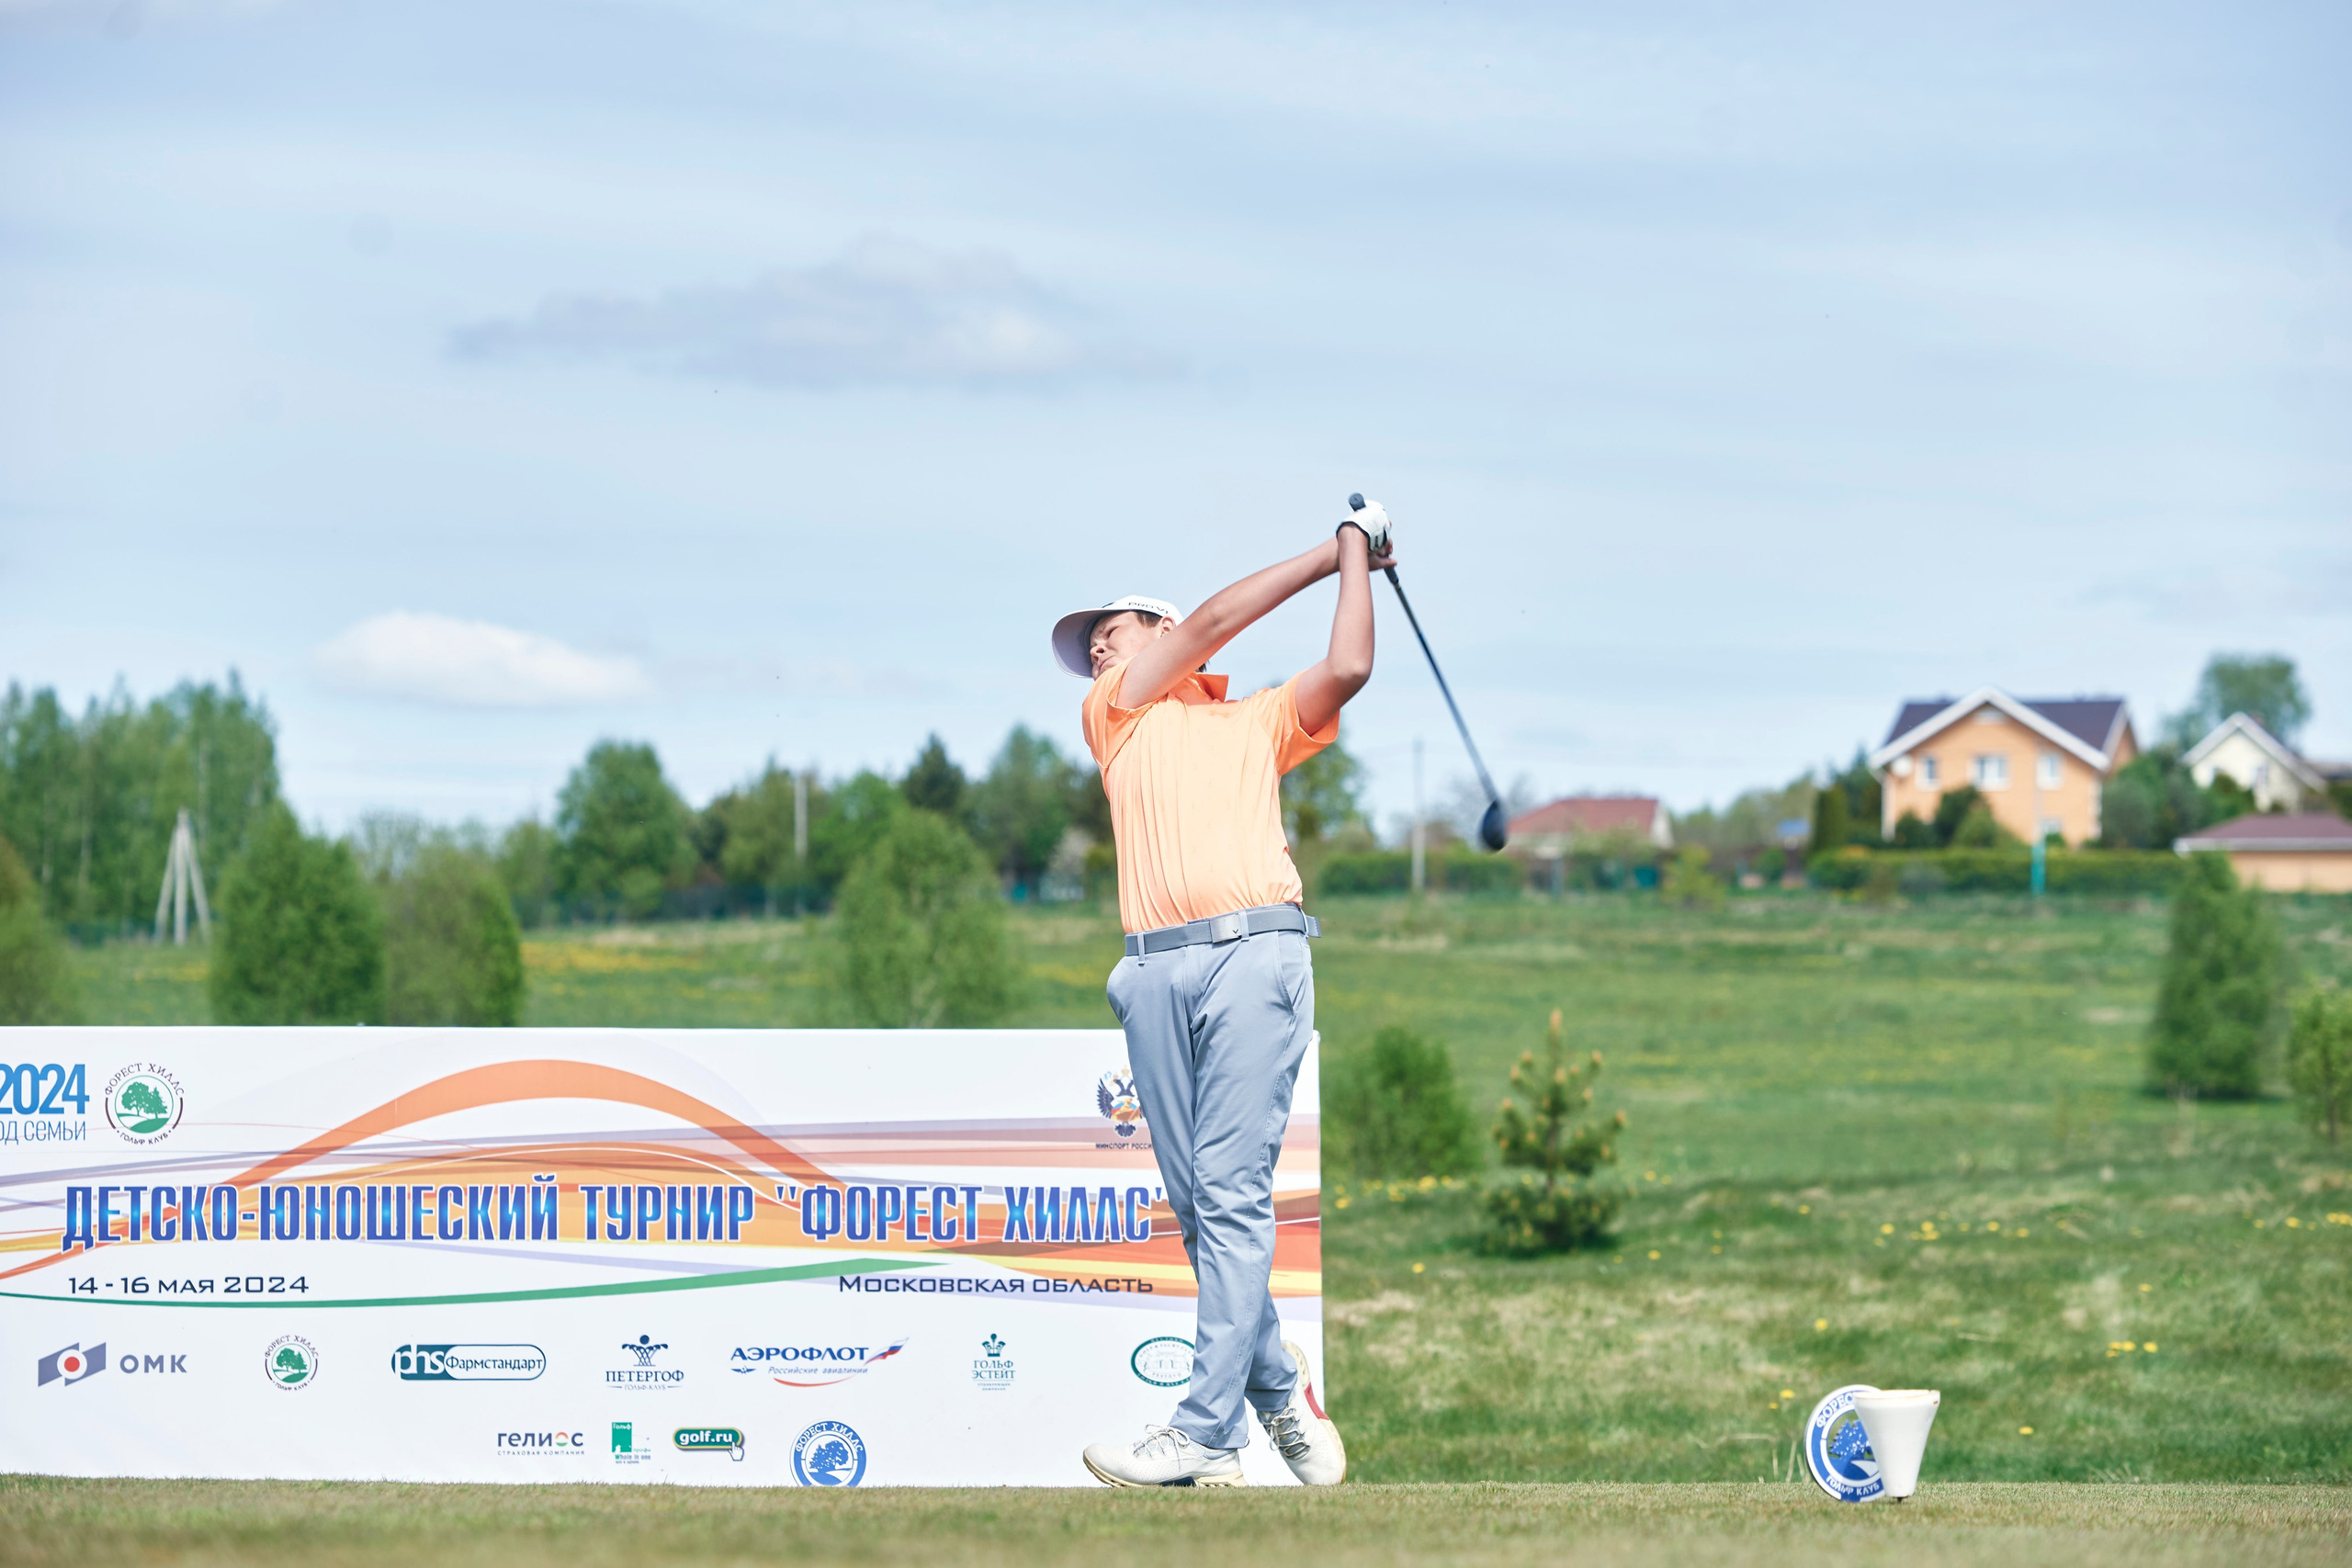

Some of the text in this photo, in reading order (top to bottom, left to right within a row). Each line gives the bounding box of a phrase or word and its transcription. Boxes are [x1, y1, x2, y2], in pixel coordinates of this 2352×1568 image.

[104, 1063, 184, 1096] ФОРЕСТ ХИЛЛС
[0, 1064, 90, 1114] 2024
[119, 1132, 168, 1145] ГОЛЬФ КЛУБ
[61, 1173, 559, 1253] ДЕТСКО-ЮНОШЕСКИЙ
[579, 1183, 754, 1241] ТУРНИР
[776, 1183, 980, 1243] "ФОРЕСТ
[224, 1277, 309, 1293] 2024
[265, 1335, 319, 1358] ФОРЕСТ ХИЛЛС
[730, 1347, 869, 1361] АЭРОФЛОТ
[119, 1354, 187, 1374] ОМК
[446, 1356, 543, 1371] Фармстандарт
[768, 1366, 819, 1374] Российские
[974, 1360, 1013, 1369] ГОЛЬФ
[605, 1370, 684, 1382] ПЕТЕРГОФ
[972, 1369, 1015, 1379] ЭСТЕЙТ
[1816, 1393, 1854, 1427] ФОРЕС
[497, 1431, 583, 1447] гелиос
[679, 1429, 733, 1446] golf.ru
[796, 1423, 864, 1452] ФОРЕСТ ХИЛЛС
[1826, 1475, 1880, 1496] ГОЛЬФ КЛУБ
